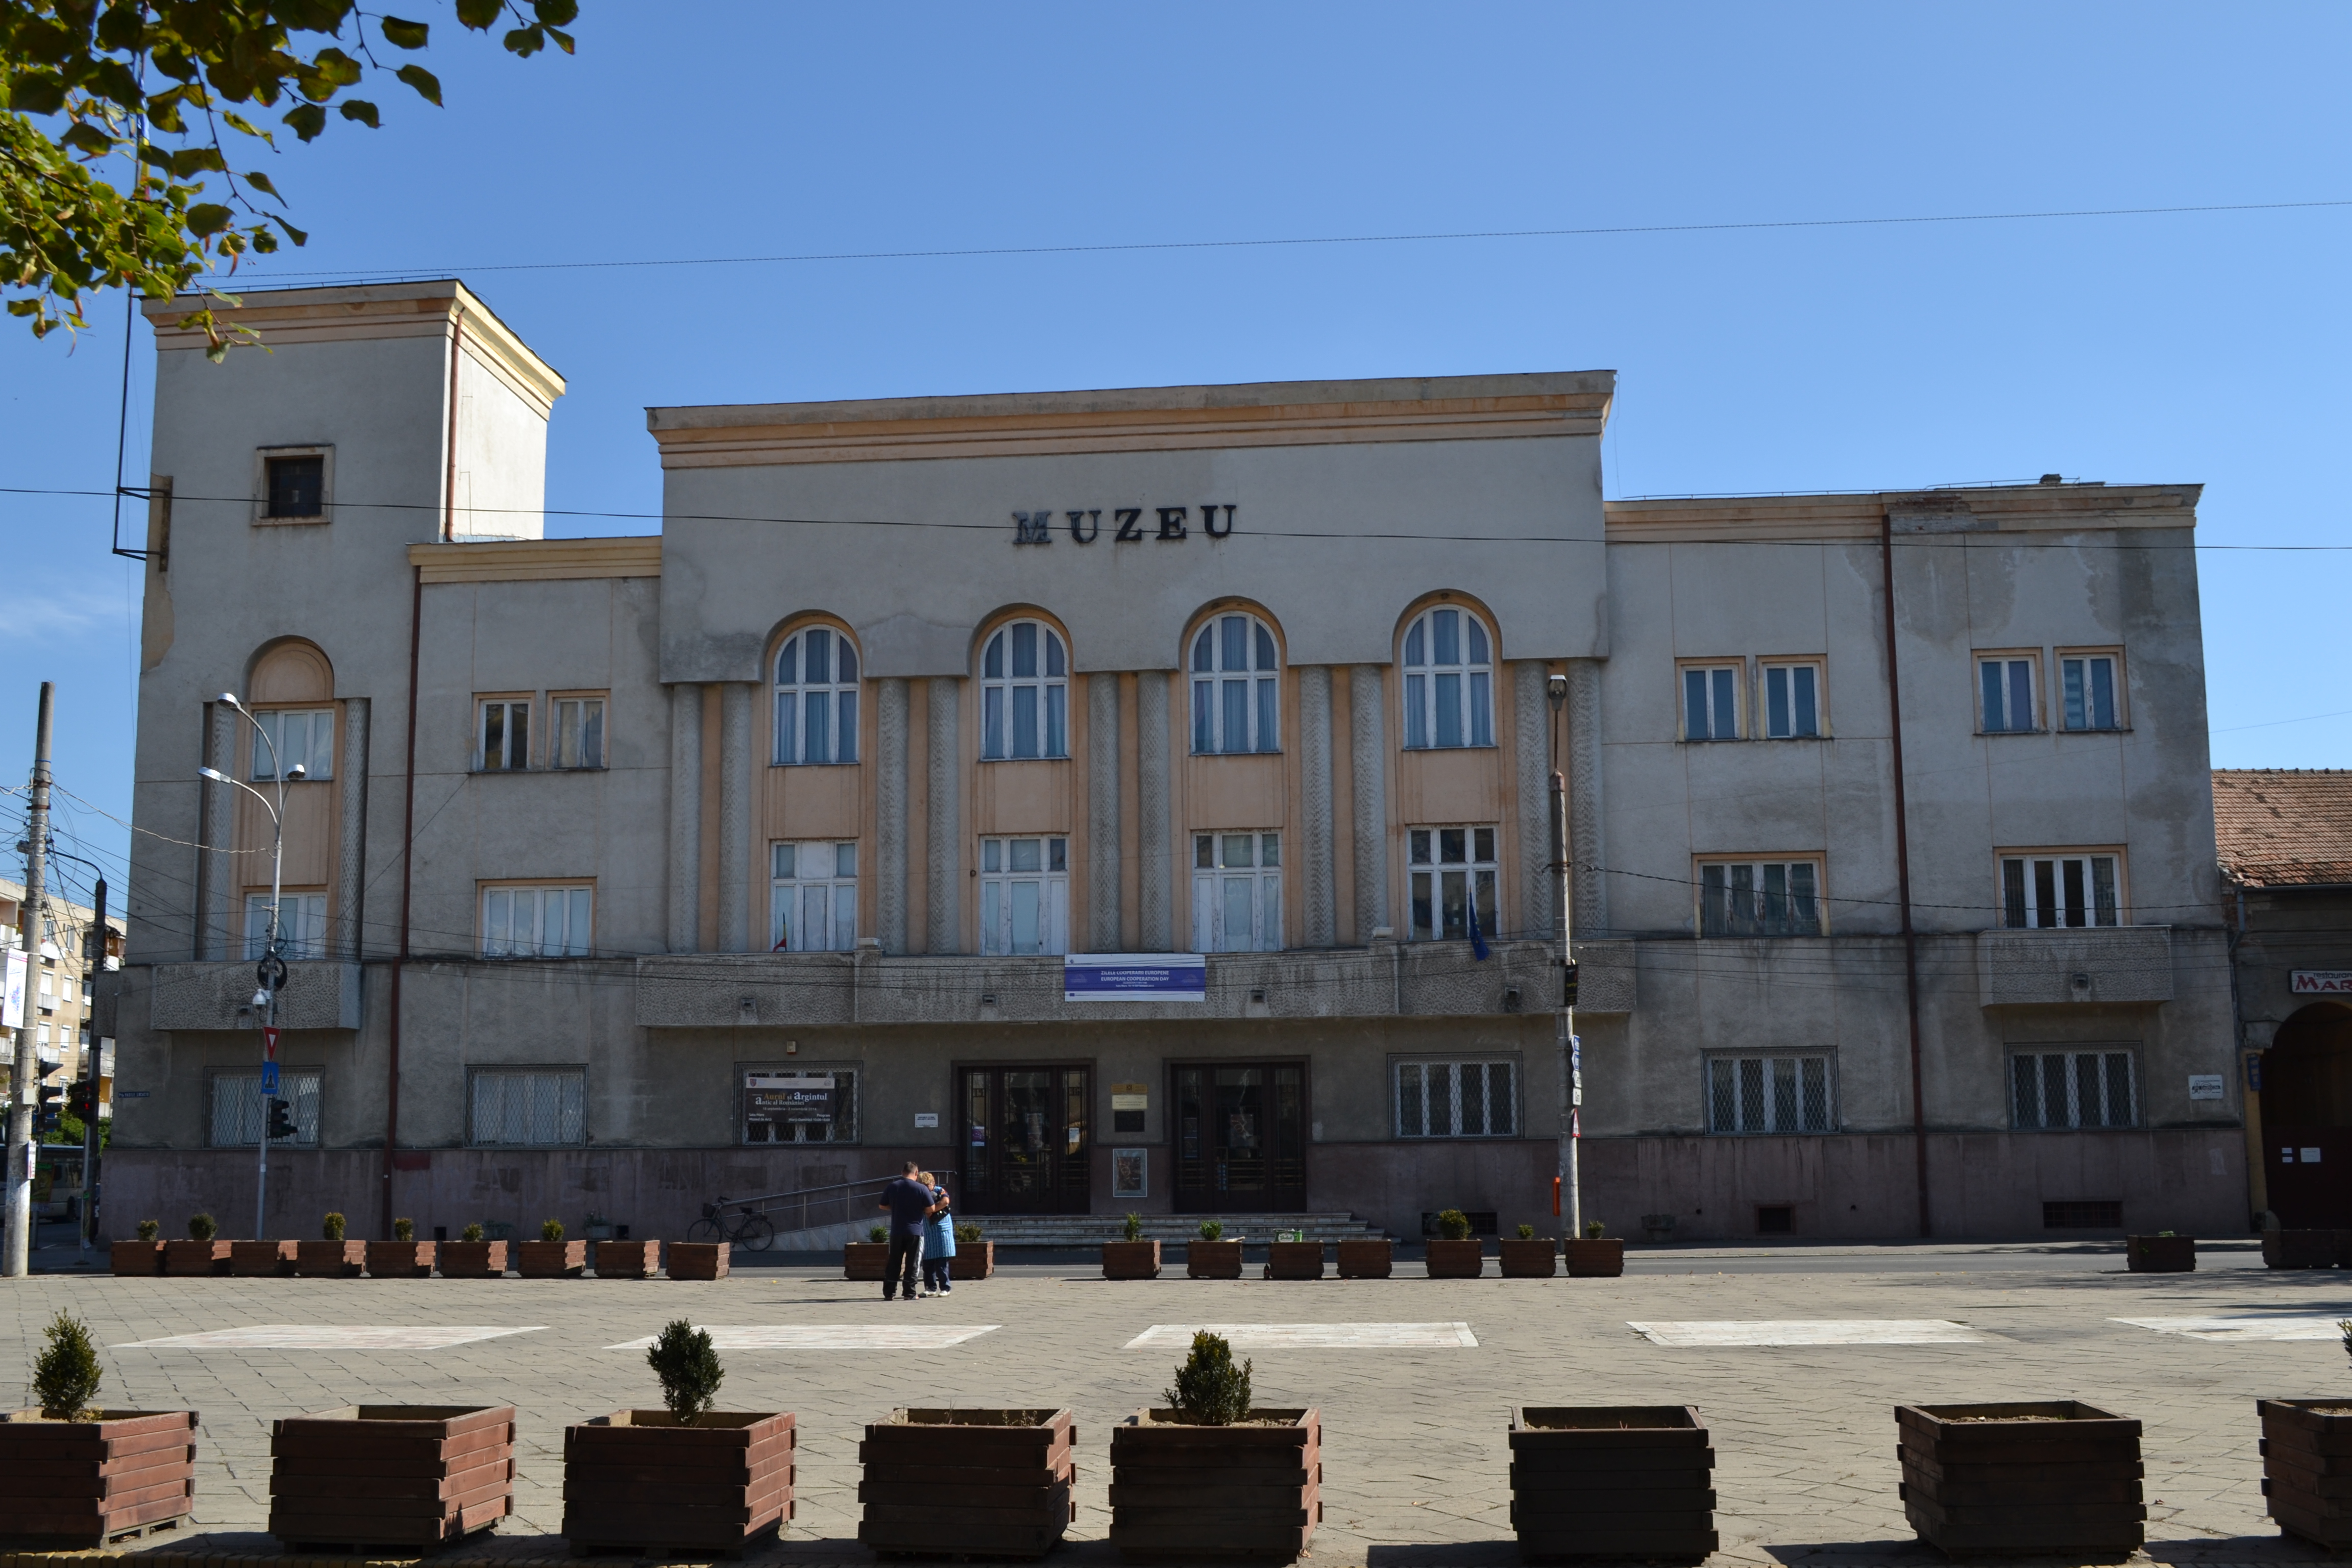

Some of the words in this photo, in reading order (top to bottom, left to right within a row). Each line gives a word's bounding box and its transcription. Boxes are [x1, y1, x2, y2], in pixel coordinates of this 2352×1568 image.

[1013, 505, 1237, 544] MUZEU
[755, 1097, 772, 1105] antic
[794, 1092, 827, 1102] argintul
